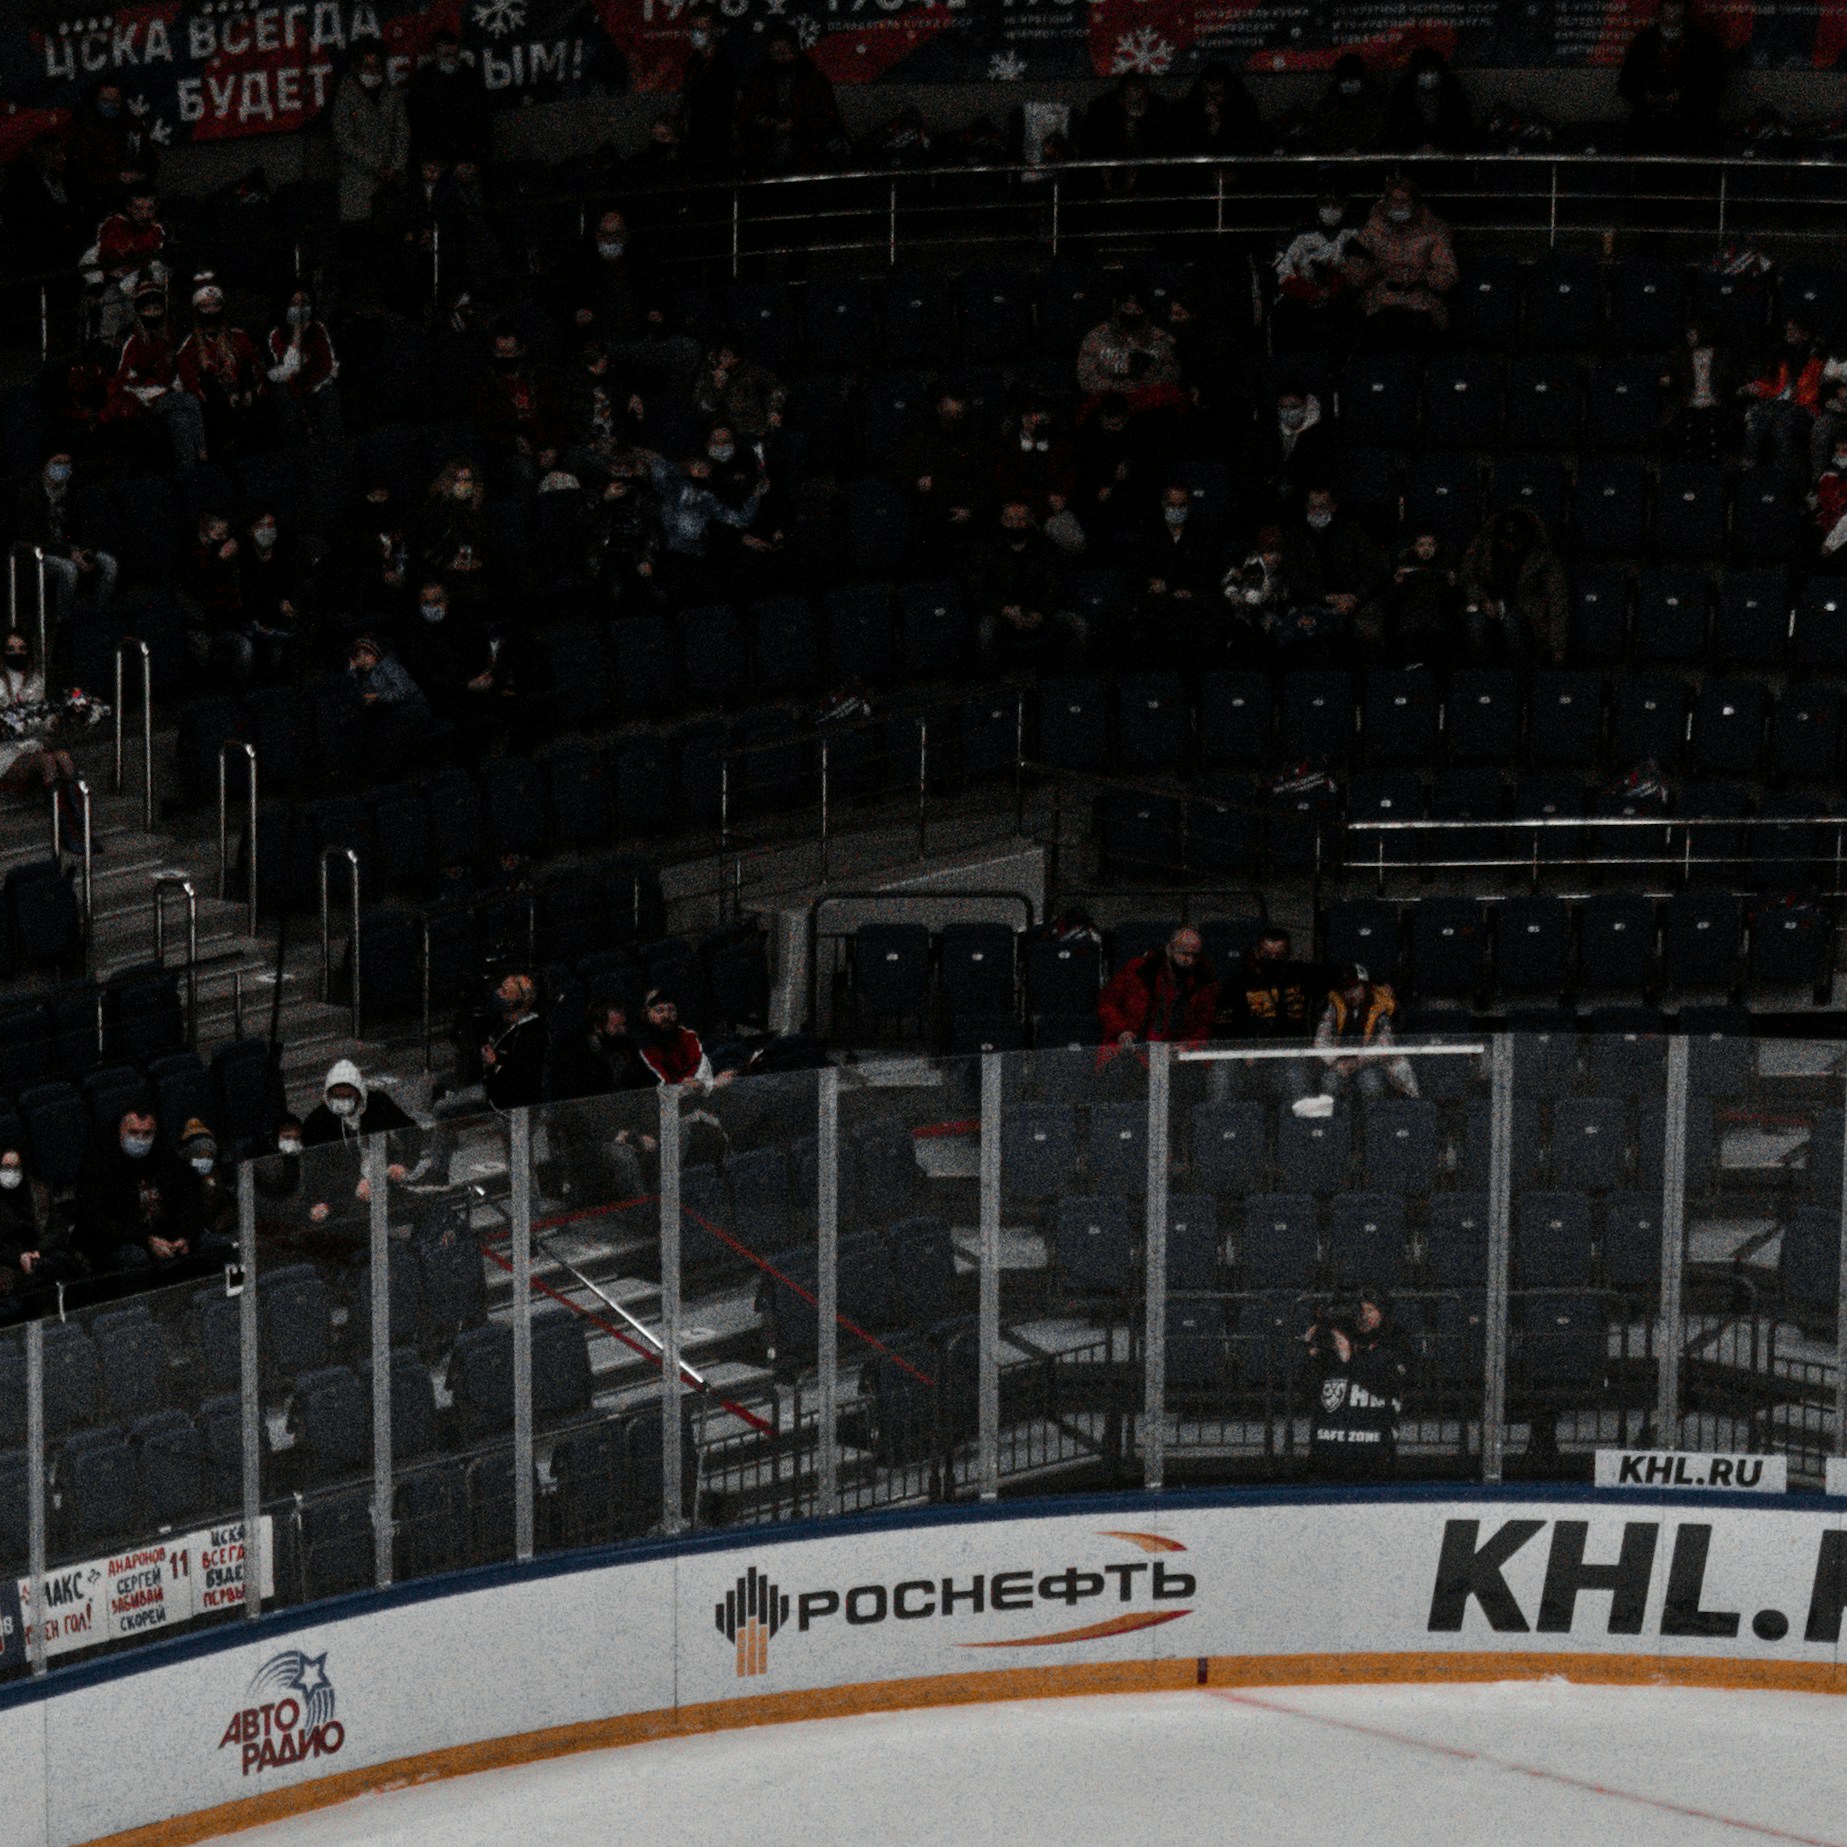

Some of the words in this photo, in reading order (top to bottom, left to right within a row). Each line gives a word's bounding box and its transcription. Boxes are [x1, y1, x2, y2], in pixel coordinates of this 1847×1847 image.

[45, 18, 174, 81] ЦСКА
[188, 1, 383, 60] ВСЕГДА
[177, 63, 334, 123] БУДЕТ
[1317, 1427, 1346, 1442] SAFE
[1347, 1430, 1382, 1444] ZONE
[1618, 1455, 1764, 1488] KHL.RU
[108, 1547, 167, 1578] АНДРОНОВ
[169, 1549, 189, 1580] 11
[205, 1564, 244, 1588] БУДЕ
[117, 1566, 162, 1595] СЕРГЕЙ
[798, 1562, 1197, 1632] РОСНЕФТЬ
[120, 1606, 166, 1633] СКОРЕЙ
[218, 1698, 301, 1750] АВТО
[242, 1720, 345, 1777] РАДИО
